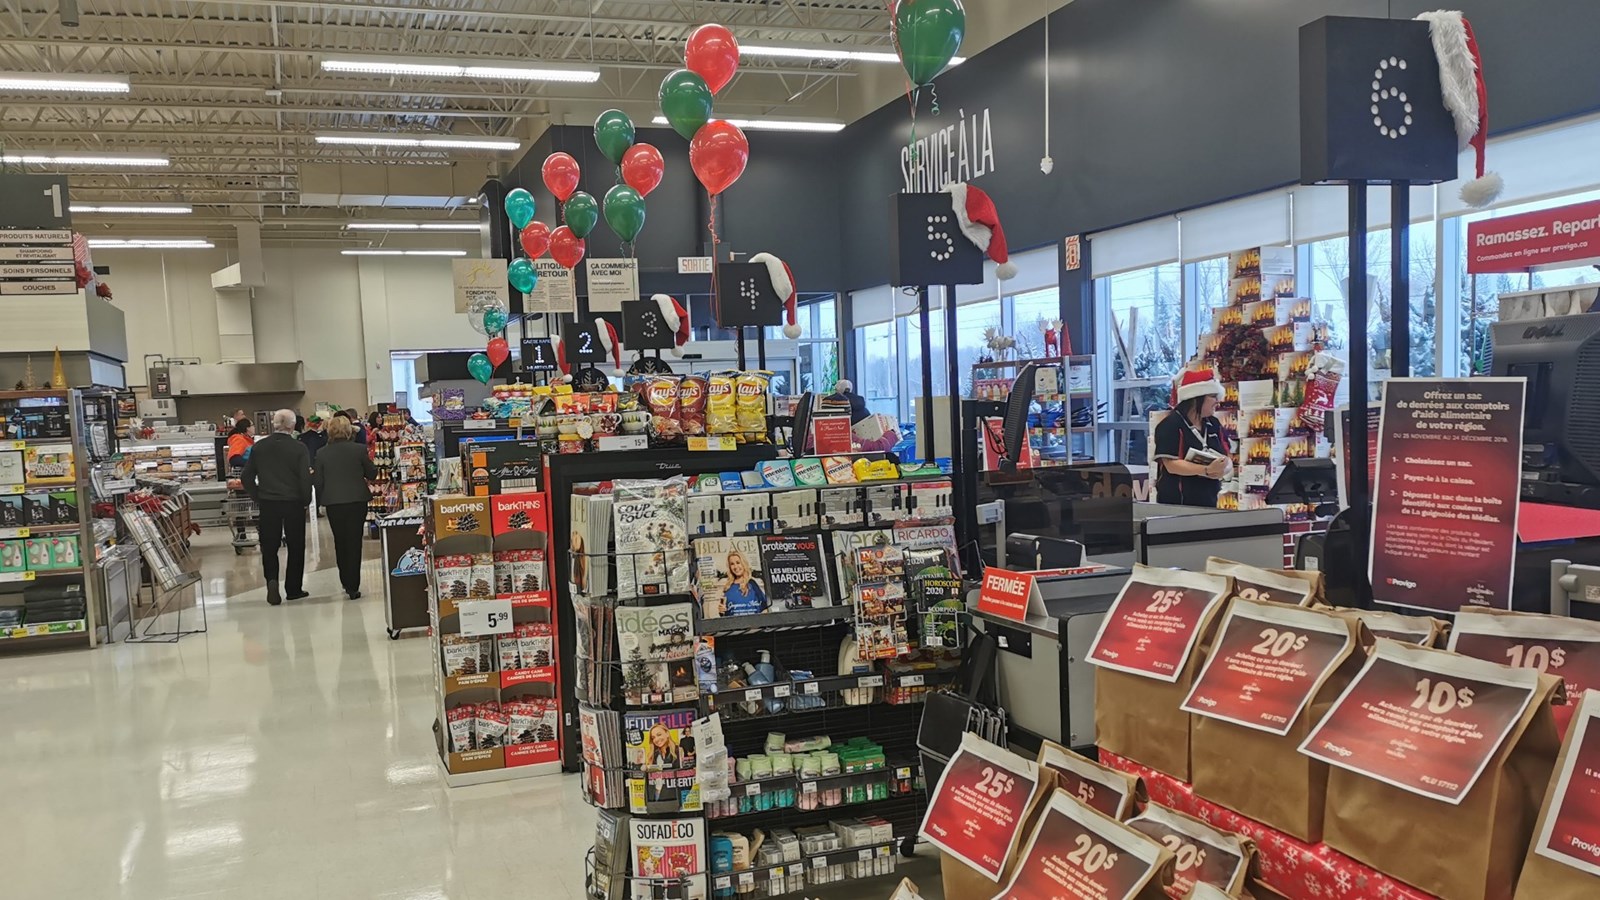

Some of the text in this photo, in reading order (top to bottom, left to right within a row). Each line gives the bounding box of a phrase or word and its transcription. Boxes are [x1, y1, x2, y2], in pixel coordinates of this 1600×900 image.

[1371, 56, 1412, 139] 6
[902, 108, 995, 193] SERVICE À LA
[44, 184, 63, 217] 1
[0, 231, 70, 240] PRODUITS NATURELS
[928, 215, 955, 260] 5
[1476, 225, 1549, 247] Ramassez.
[1476, 251, 1513, 263] Commandez
[1513, 250, 1522, 258] en
[1523, 246, 1540, 259] ligne
[1540, 246, 1551, 254] sur
[3, 266, 72, 275] SOINS PERSONNELS
[602, 261, 637, 270] COMMENCE
[682, 258, 710, 273] SORTIE
[536, 270, 569, 280] RETOUR
[591, 270, 623, 279] AVEC MOI
[22, 285, 56, 293] COUCHES
[740, 277, 760, 310] 4
[641, 311, 658, 338] 3
[1522, 325, 1565, 339] DELL
[578, 332, 593, 353] 2
[534, 345, 545, 363] 1
[1424, 391, 1452, 400] Offrez
[1397, 400, 1407, 409] de
[1409, 400, 1444, 410] denrées
[1464, 402, 1511, 412] comptoirs
[1412, 410, 1492, 420] d'aide alimentaire
[1416, 420, 1486, 432] de votre région.
[1411, 433, 1442, 441] NOVEMBRE
[1461, 434, 1493, 443] DÉCEMBRE
[796, 462, 820, 477] mentos
[827, 461, 852, 476] mentos
[1405, 457, 1445, 466] Choisissez
[1457, 460, 1473, 468] sac.
[1404, 474, 1434, 483] Payez-le
[1441, 475, 1449, 483] la
[1450, 477, 1475, 486] caisse.
[1403, 490, 1433, 500] Déposez
[1433, 492, 1441, 500] le
[1455, 494, 1474, 503] dans
[1475, 495, 1482, 503] la
[1483, 495, 1503, 505] boîte
[440, 501, 541, 514] barkTHINS barkTHINS
[617, 503, 651, 515] COUP
[1401, 507, 1411, 515] de
[1411, 508, 1421, 516] La
[1422, 509, 1456, 520] guignolée
[1457, 511, 1471, 521] des
[1451, 503, 1484, 513] couleurs
[620, 510, 660, 524] POUCE
[898, 528, 950, 542] RICARDO
[697, 540, 726, 555] BEL
[907, 557, 925, 565] 2020
[770, 566, 816, 575] LES MEILLEURES
[771, 572, 817, 585] MARQUES
[924, 580, 962, 590] HOROSCOPE
[986, 574, 1026, 597] FERMÉE
[1392, 578, 1417, 590] Provigo
[926, 586, 944, 596] 2020
[1146, 590, 1184, 613] 25$
[928, 605, 957, 614] SCORPION
[618, 610, 690, 635] idées
[658, 625, 690, 638] MAISON
[446, 638, 550, 656] barkTHINS barkTHINS
[1251, 628, 1309, 658] 20$
[1506, 644, 1567, 675] 10$
[532, 668, 544, 676] CANE
[536, 672, 551, 680] BONBON
[1411, 677, 1475, 714] 10$
[660, 712, 693, 731] FILLE
[974, 766, 1016, 799] 25$
[637, 820, 694, 841] SOFADÉCO
[1066, 834, 1119, 874] 20$
